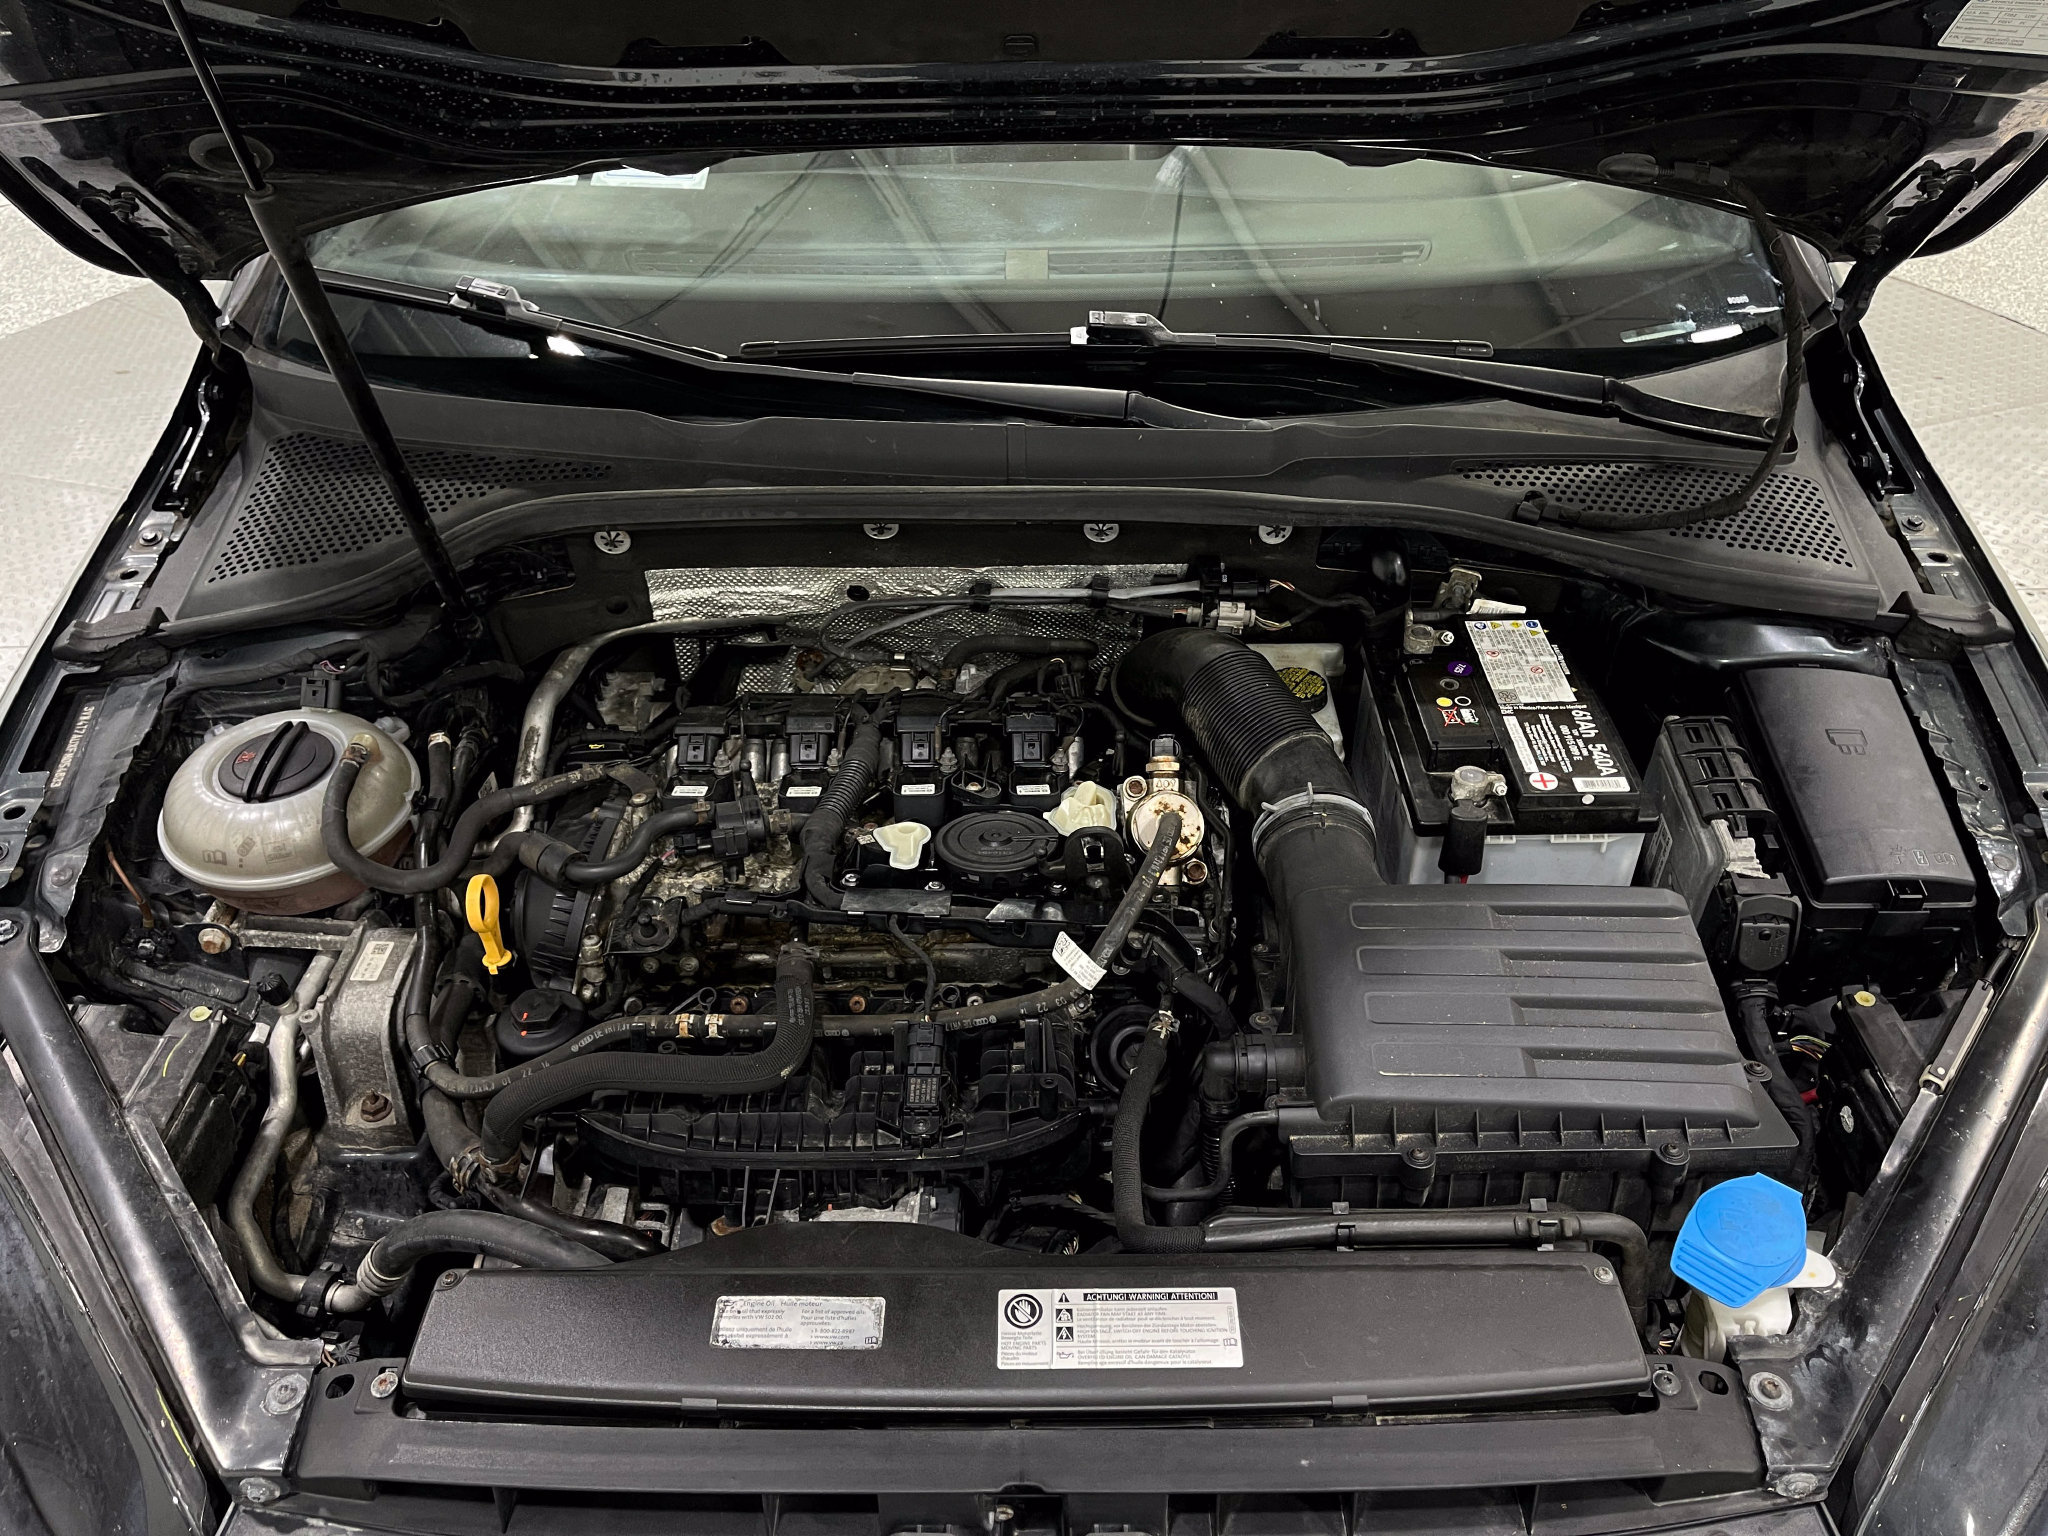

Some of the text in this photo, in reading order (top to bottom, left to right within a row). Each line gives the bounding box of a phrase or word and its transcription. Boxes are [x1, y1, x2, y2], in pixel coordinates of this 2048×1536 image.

[1571, 709, 1619, 777] 61Ah 540A
[1036, 1002, 1049, 1013] 22
[664, 1020, 674, 1029] 22
[1086, 1293, 1127, 1301] ACHTUNG!
[1170, 1292, 1216, 1300] ATTENTION!
